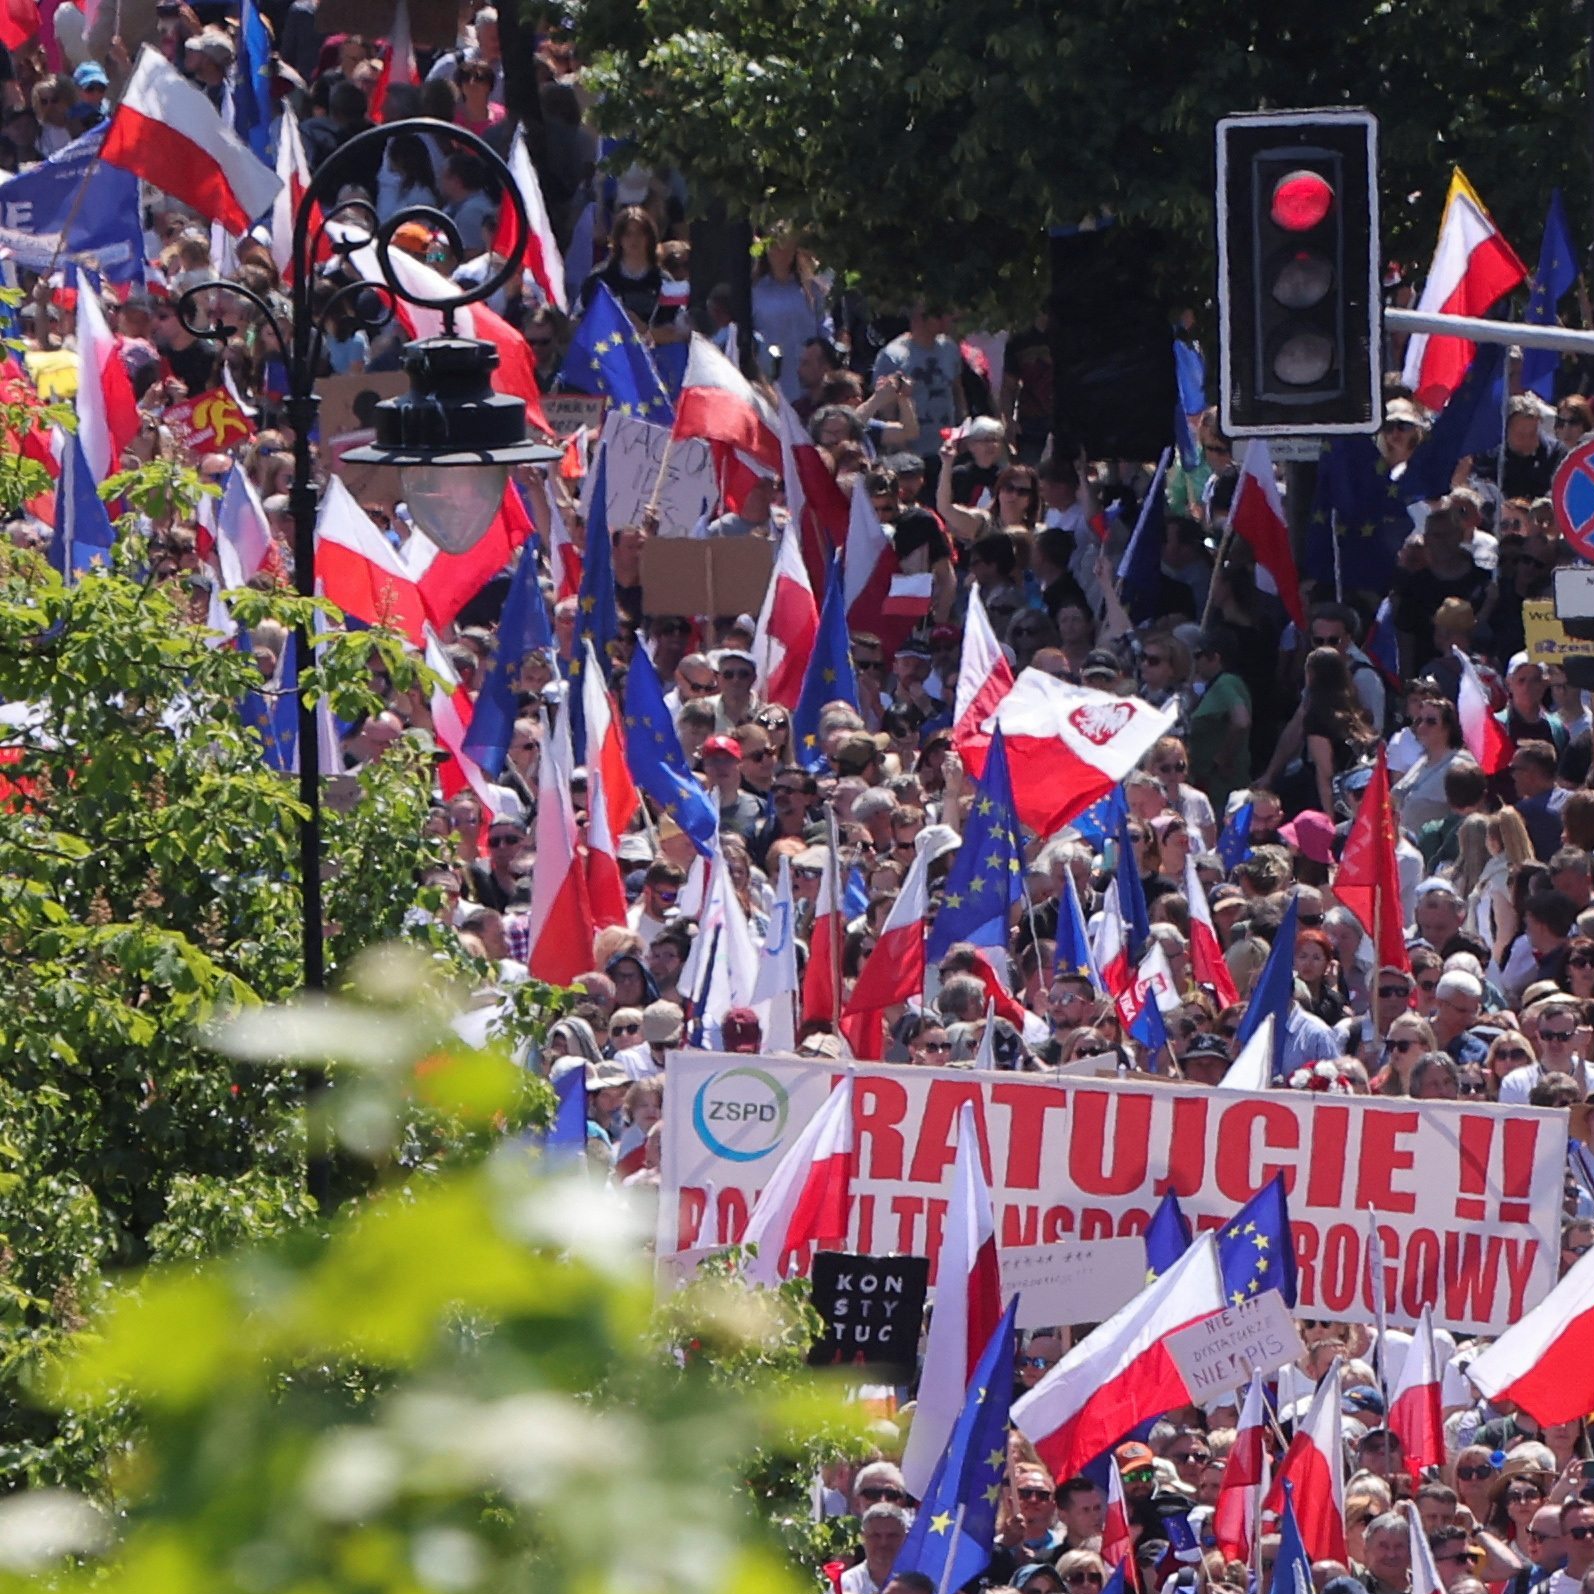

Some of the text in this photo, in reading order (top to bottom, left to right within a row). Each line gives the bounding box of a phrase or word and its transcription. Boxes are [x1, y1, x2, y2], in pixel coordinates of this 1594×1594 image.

[707, 1100, 777, 1123] ZSPD
[831, 1074, 1541, 1225] RATUJCIE !!
[836, 1273, 903, 1294] KON
[1290, 1219, 1541, 1326] ROGOWY
[833, 1297, 899, 1318] STY
[832, 1322, 893, 1343] TUC
[1204, 1311, 1233, 1335] NIE
[1244, 1333, 1285, 1367] PIS
